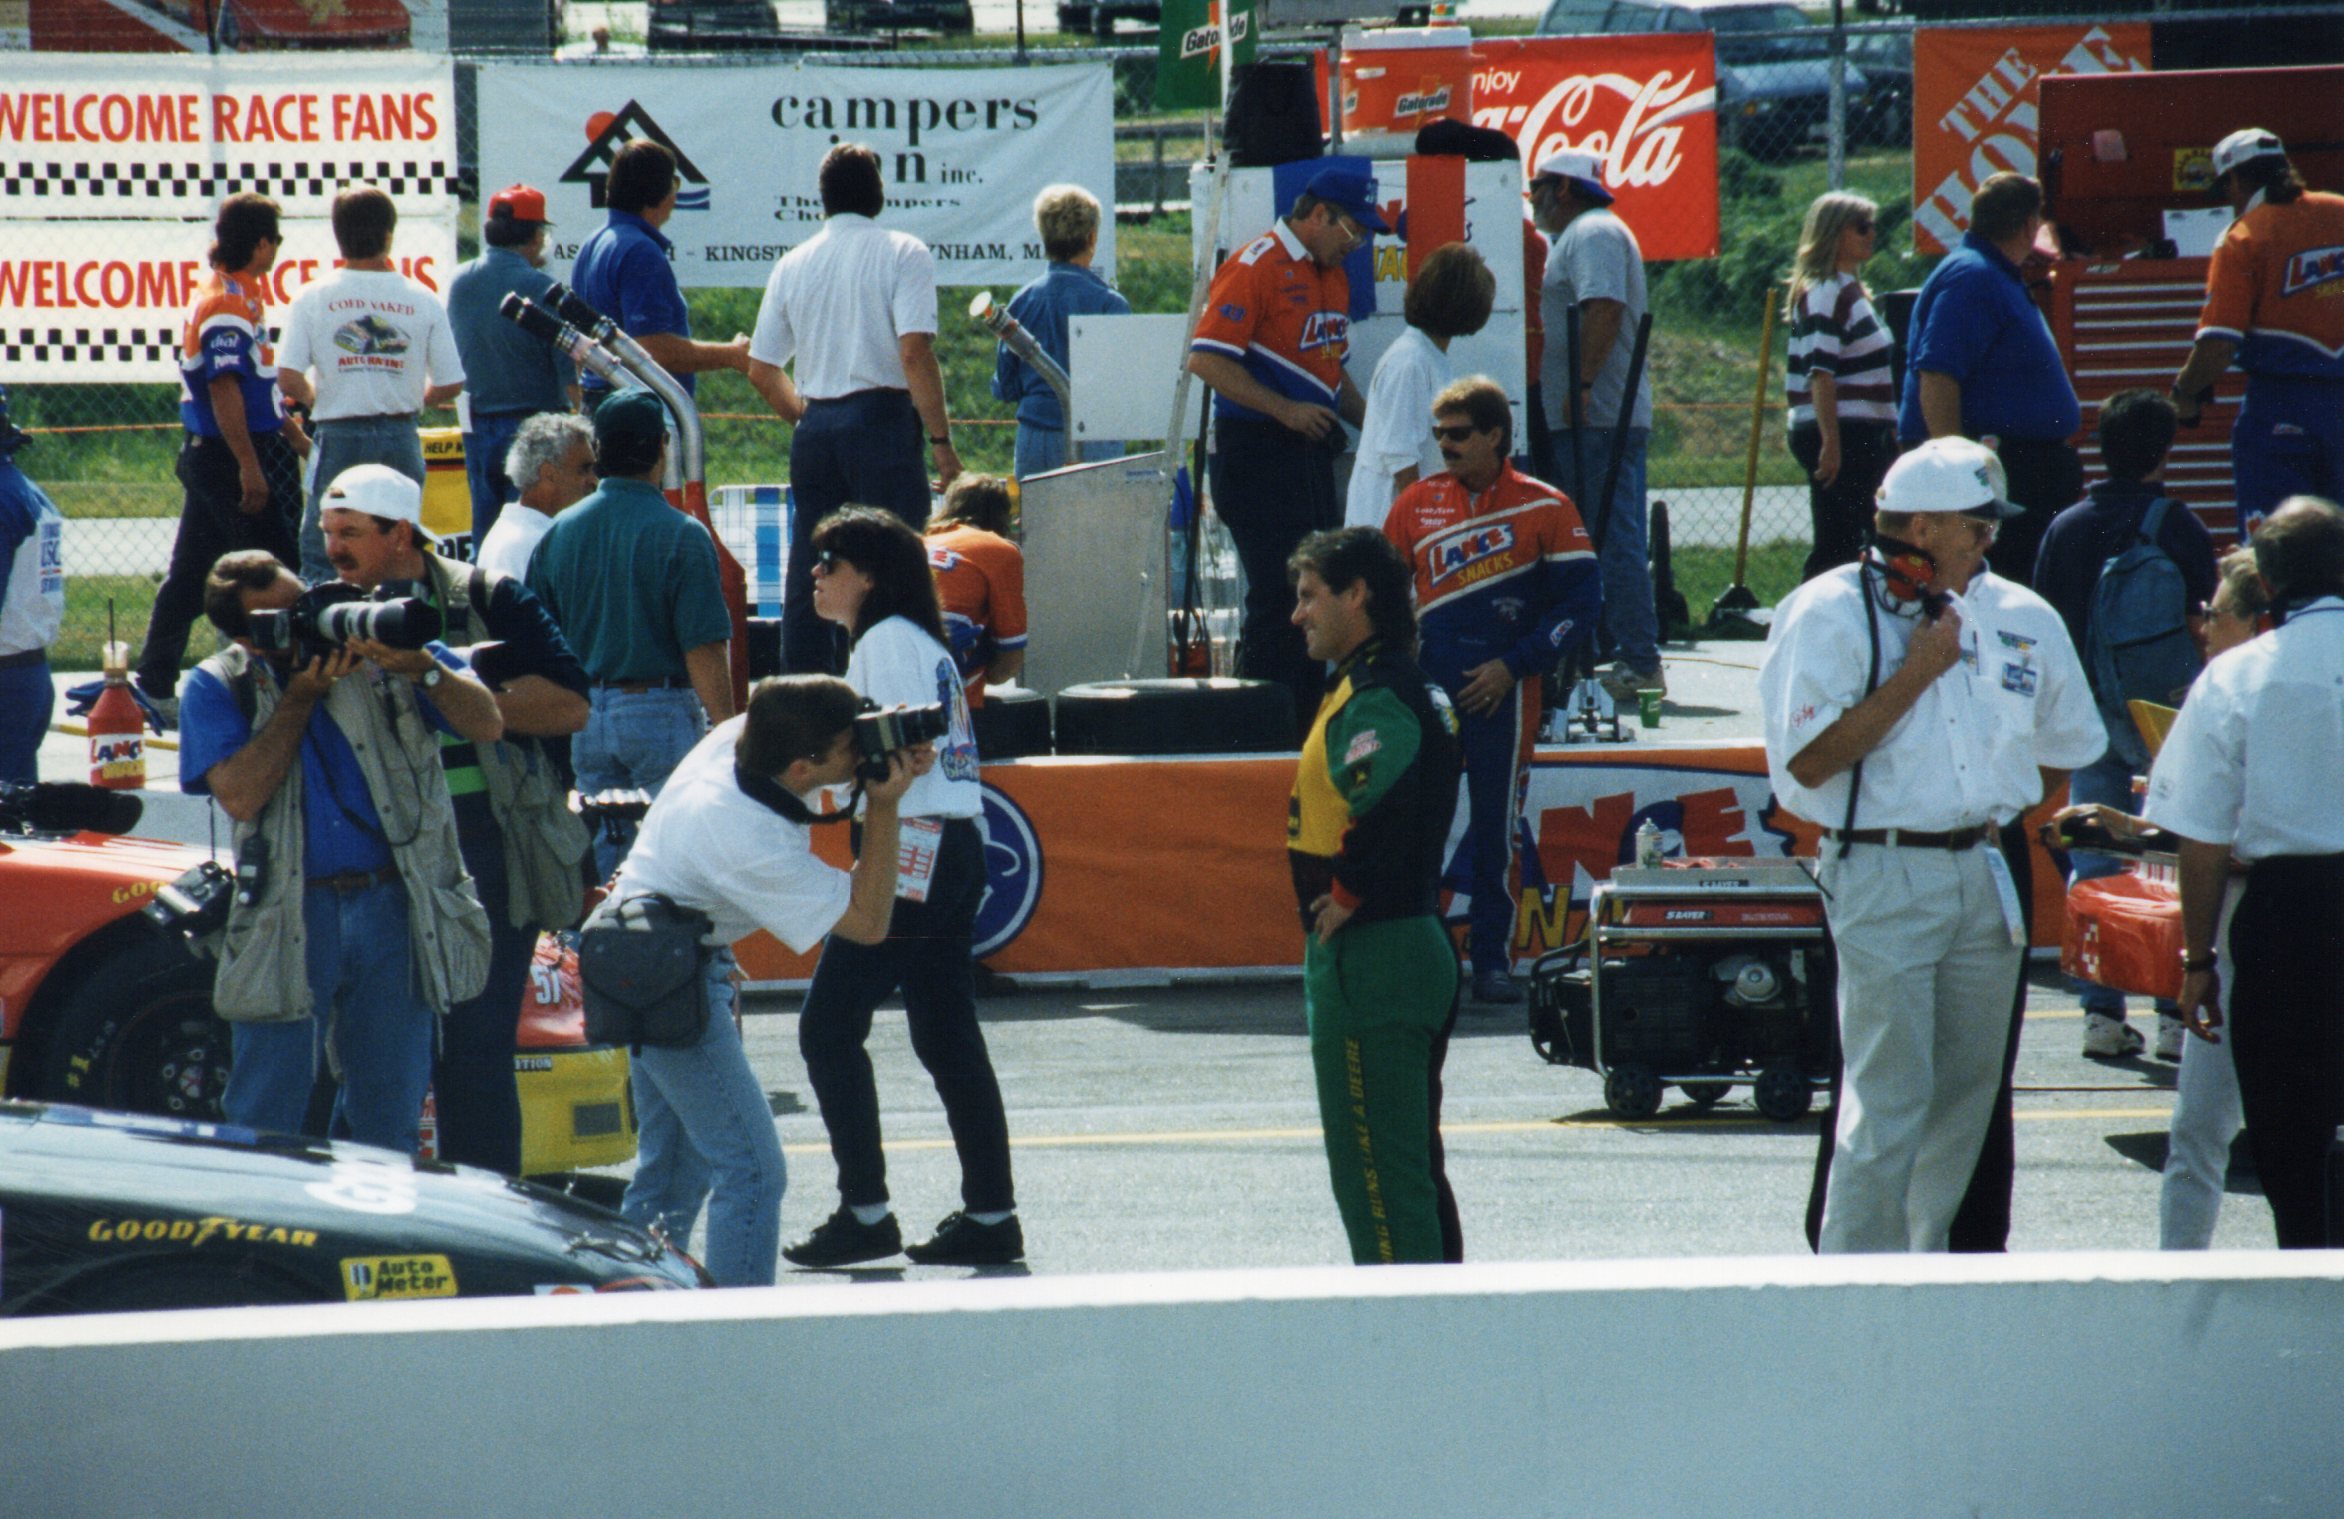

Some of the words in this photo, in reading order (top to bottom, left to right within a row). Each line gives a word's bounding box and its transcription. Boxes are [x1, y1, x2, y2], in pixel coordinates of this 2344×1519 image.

[1184, 19, 1247, 50] Gatode
[1472, 67, 1521, 95] njoy
[1398, 94, 1448, 113] Gatorade
[1938, 47, 2039, 144] THE
[0, 93, 200, 143] WELCOME
[212, 94, 320, 143] RACE
[331, 92, 438, 142] FANS
[771, 95, 1038, 147] campers
[940, 162, 983, 184] inc.
[774, 209, 826, 221] Cho
[886, 198, 961, 209] mpers
[705, 245, 789, 261] KINGST
[1457, 551, 1515, 586] SNACKS
[529, 964, 562, 1004] 51
[87, 1215, 319, 1248] GOODYEAR
[377, 1259, 434, 1277] Auto
[378, 1273, 447, 1291] Meter
